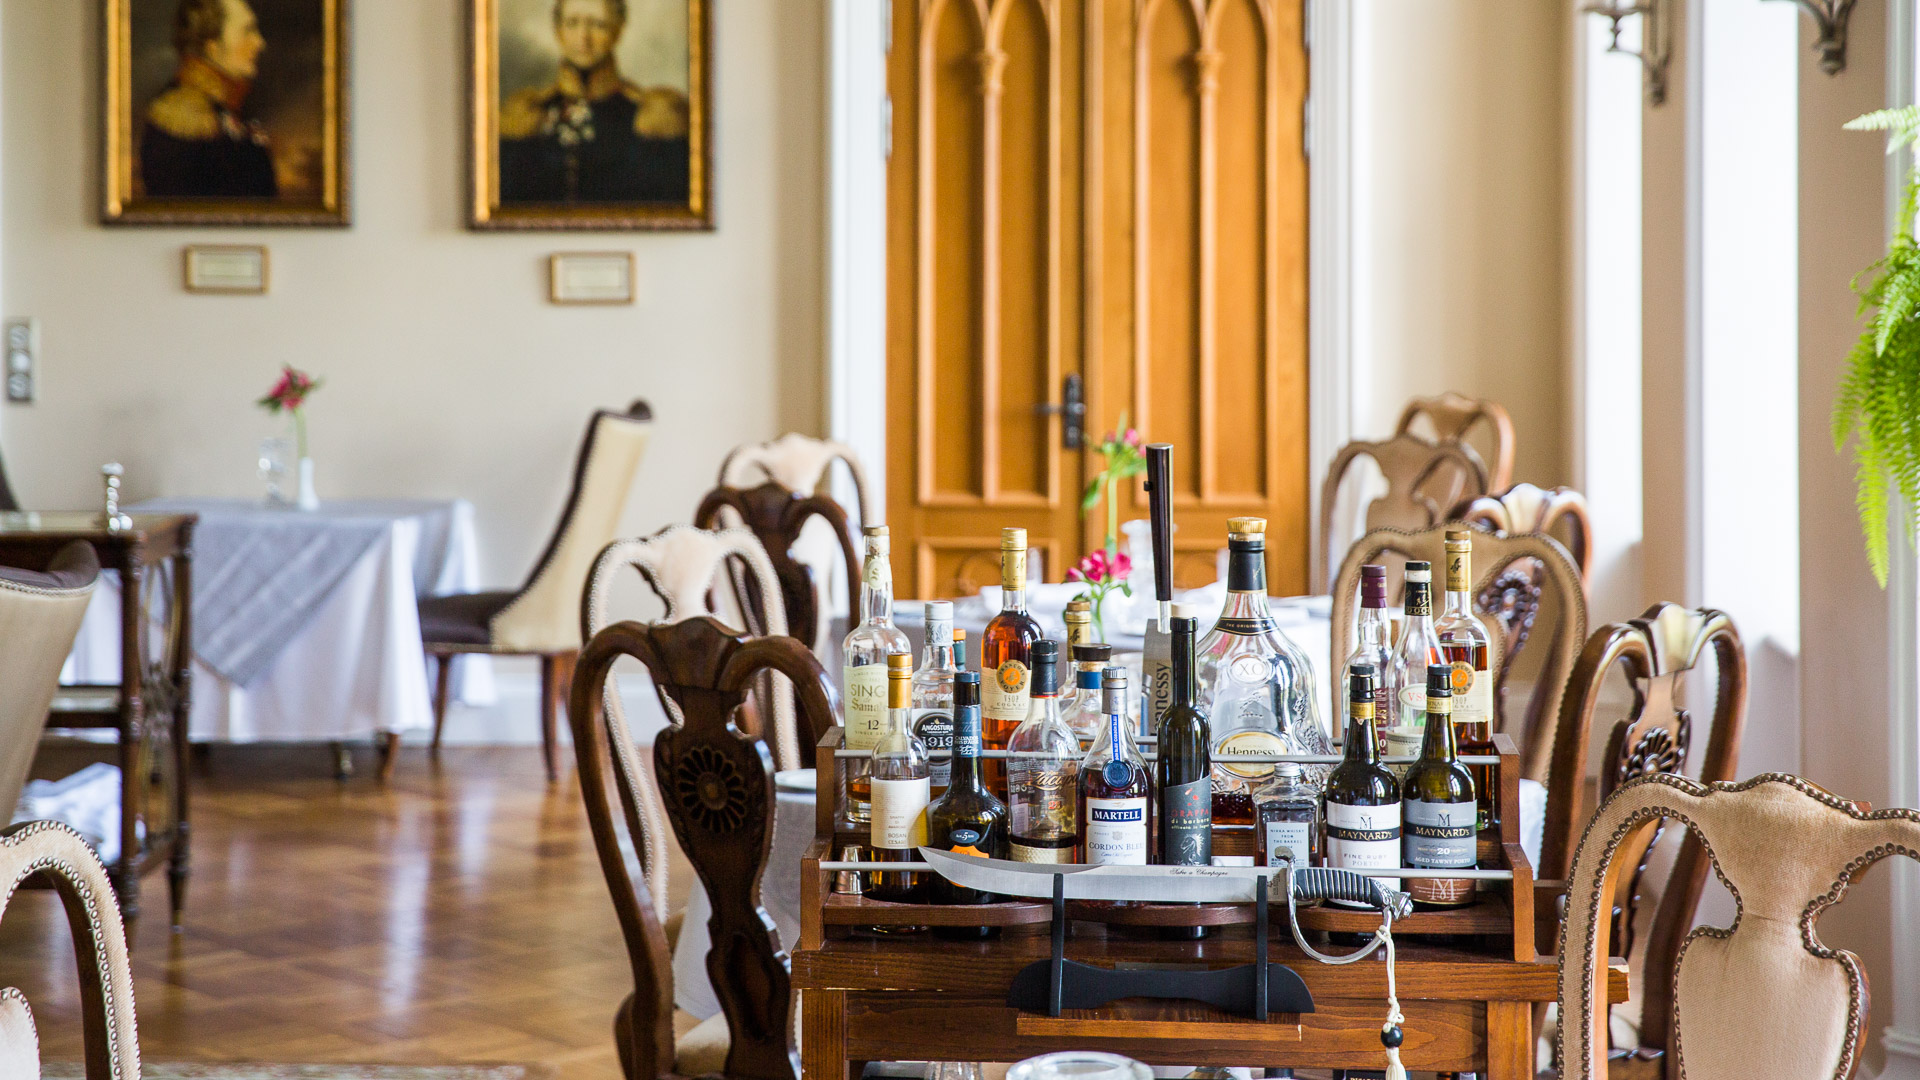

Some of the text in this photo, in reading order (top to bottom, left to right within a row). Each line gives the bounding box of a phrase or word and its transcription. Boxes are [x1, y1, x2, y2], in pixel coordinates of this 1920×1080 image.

[850, 683, 886, 697] SING
[1150, 662, 1171, 736] nessy
[867, 719, 880, 730] 12
[921, 724, 953, 732] ANGOSTURA
[921, 736, 953, 747] 1919
[1094, 810, 1140, 820] MARTELL
[1170, 808, 1209, 818] GRAPPA
[1437, 813, 1451, 827] M
[1088, 841, 1124, 851] CORDON
[1436, 847, 1451, 855] 20
